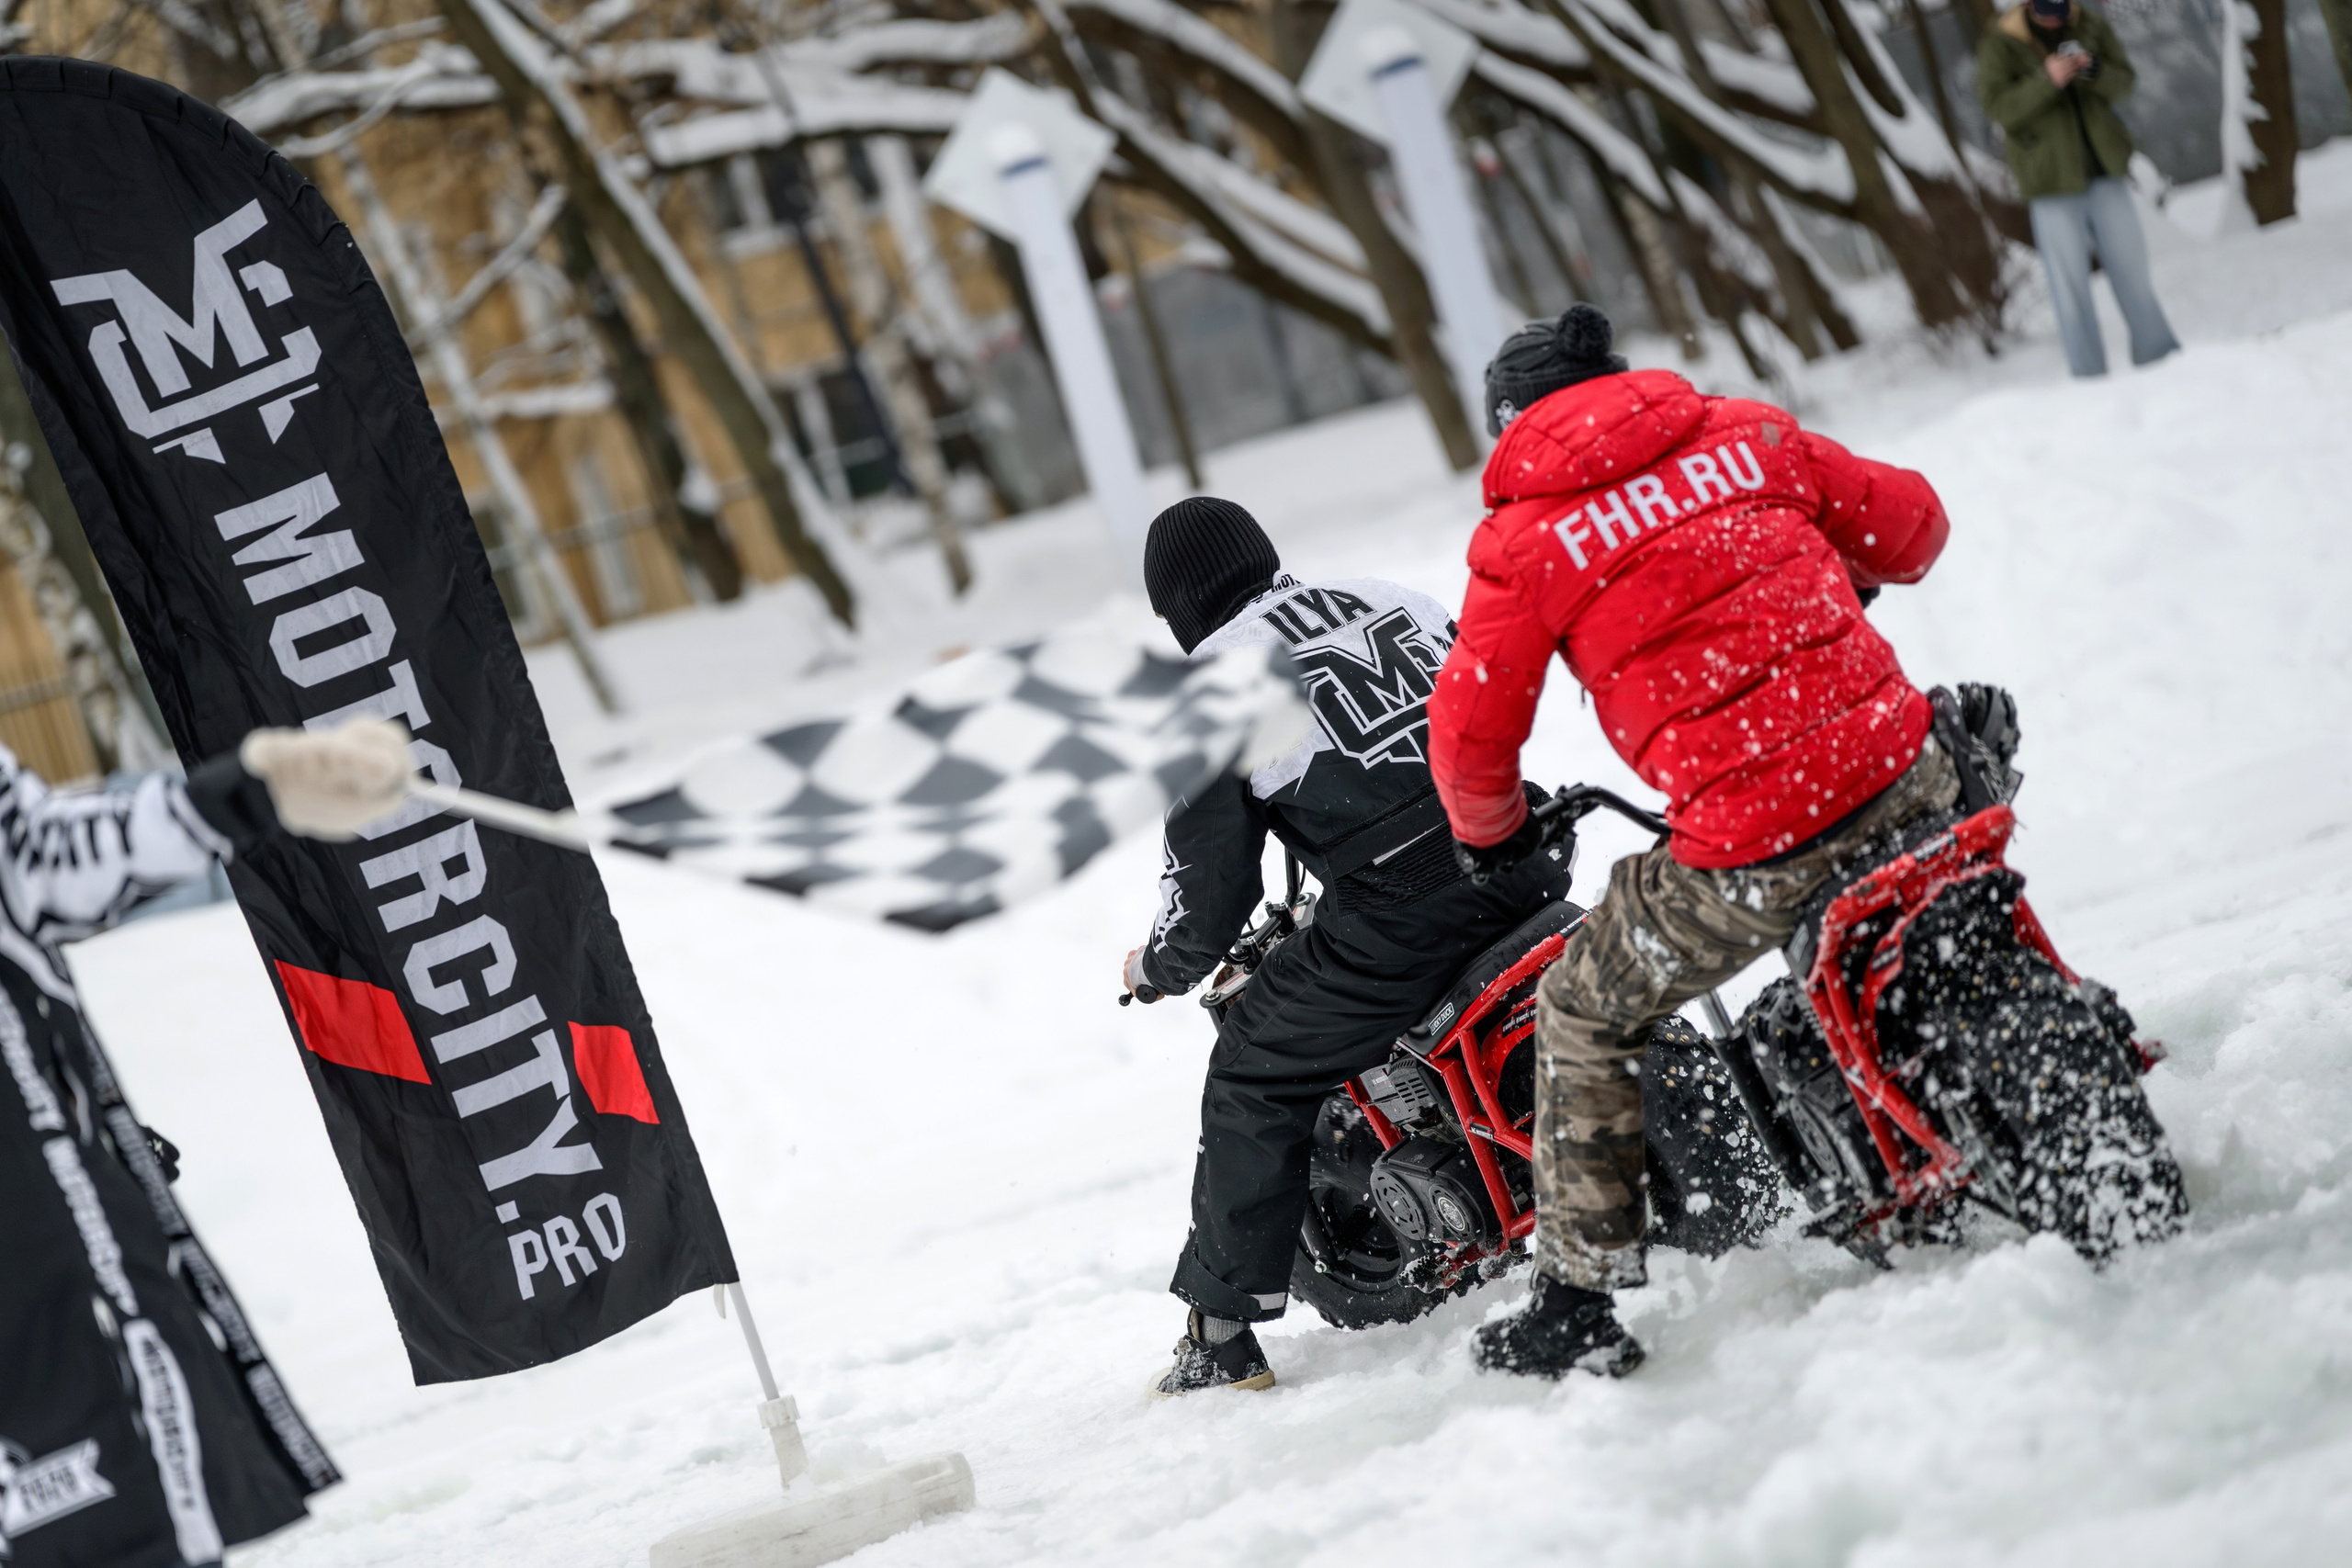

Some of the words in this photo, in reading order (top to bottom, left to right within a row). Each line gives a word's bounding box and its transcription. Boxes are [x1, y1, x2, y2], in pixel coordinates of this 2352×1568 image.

[1553, 441, 1766, 571] FHR.RU
[1259, 587, 1377, 647] ILYA
[507, 1192, 626, 1301] PRO
